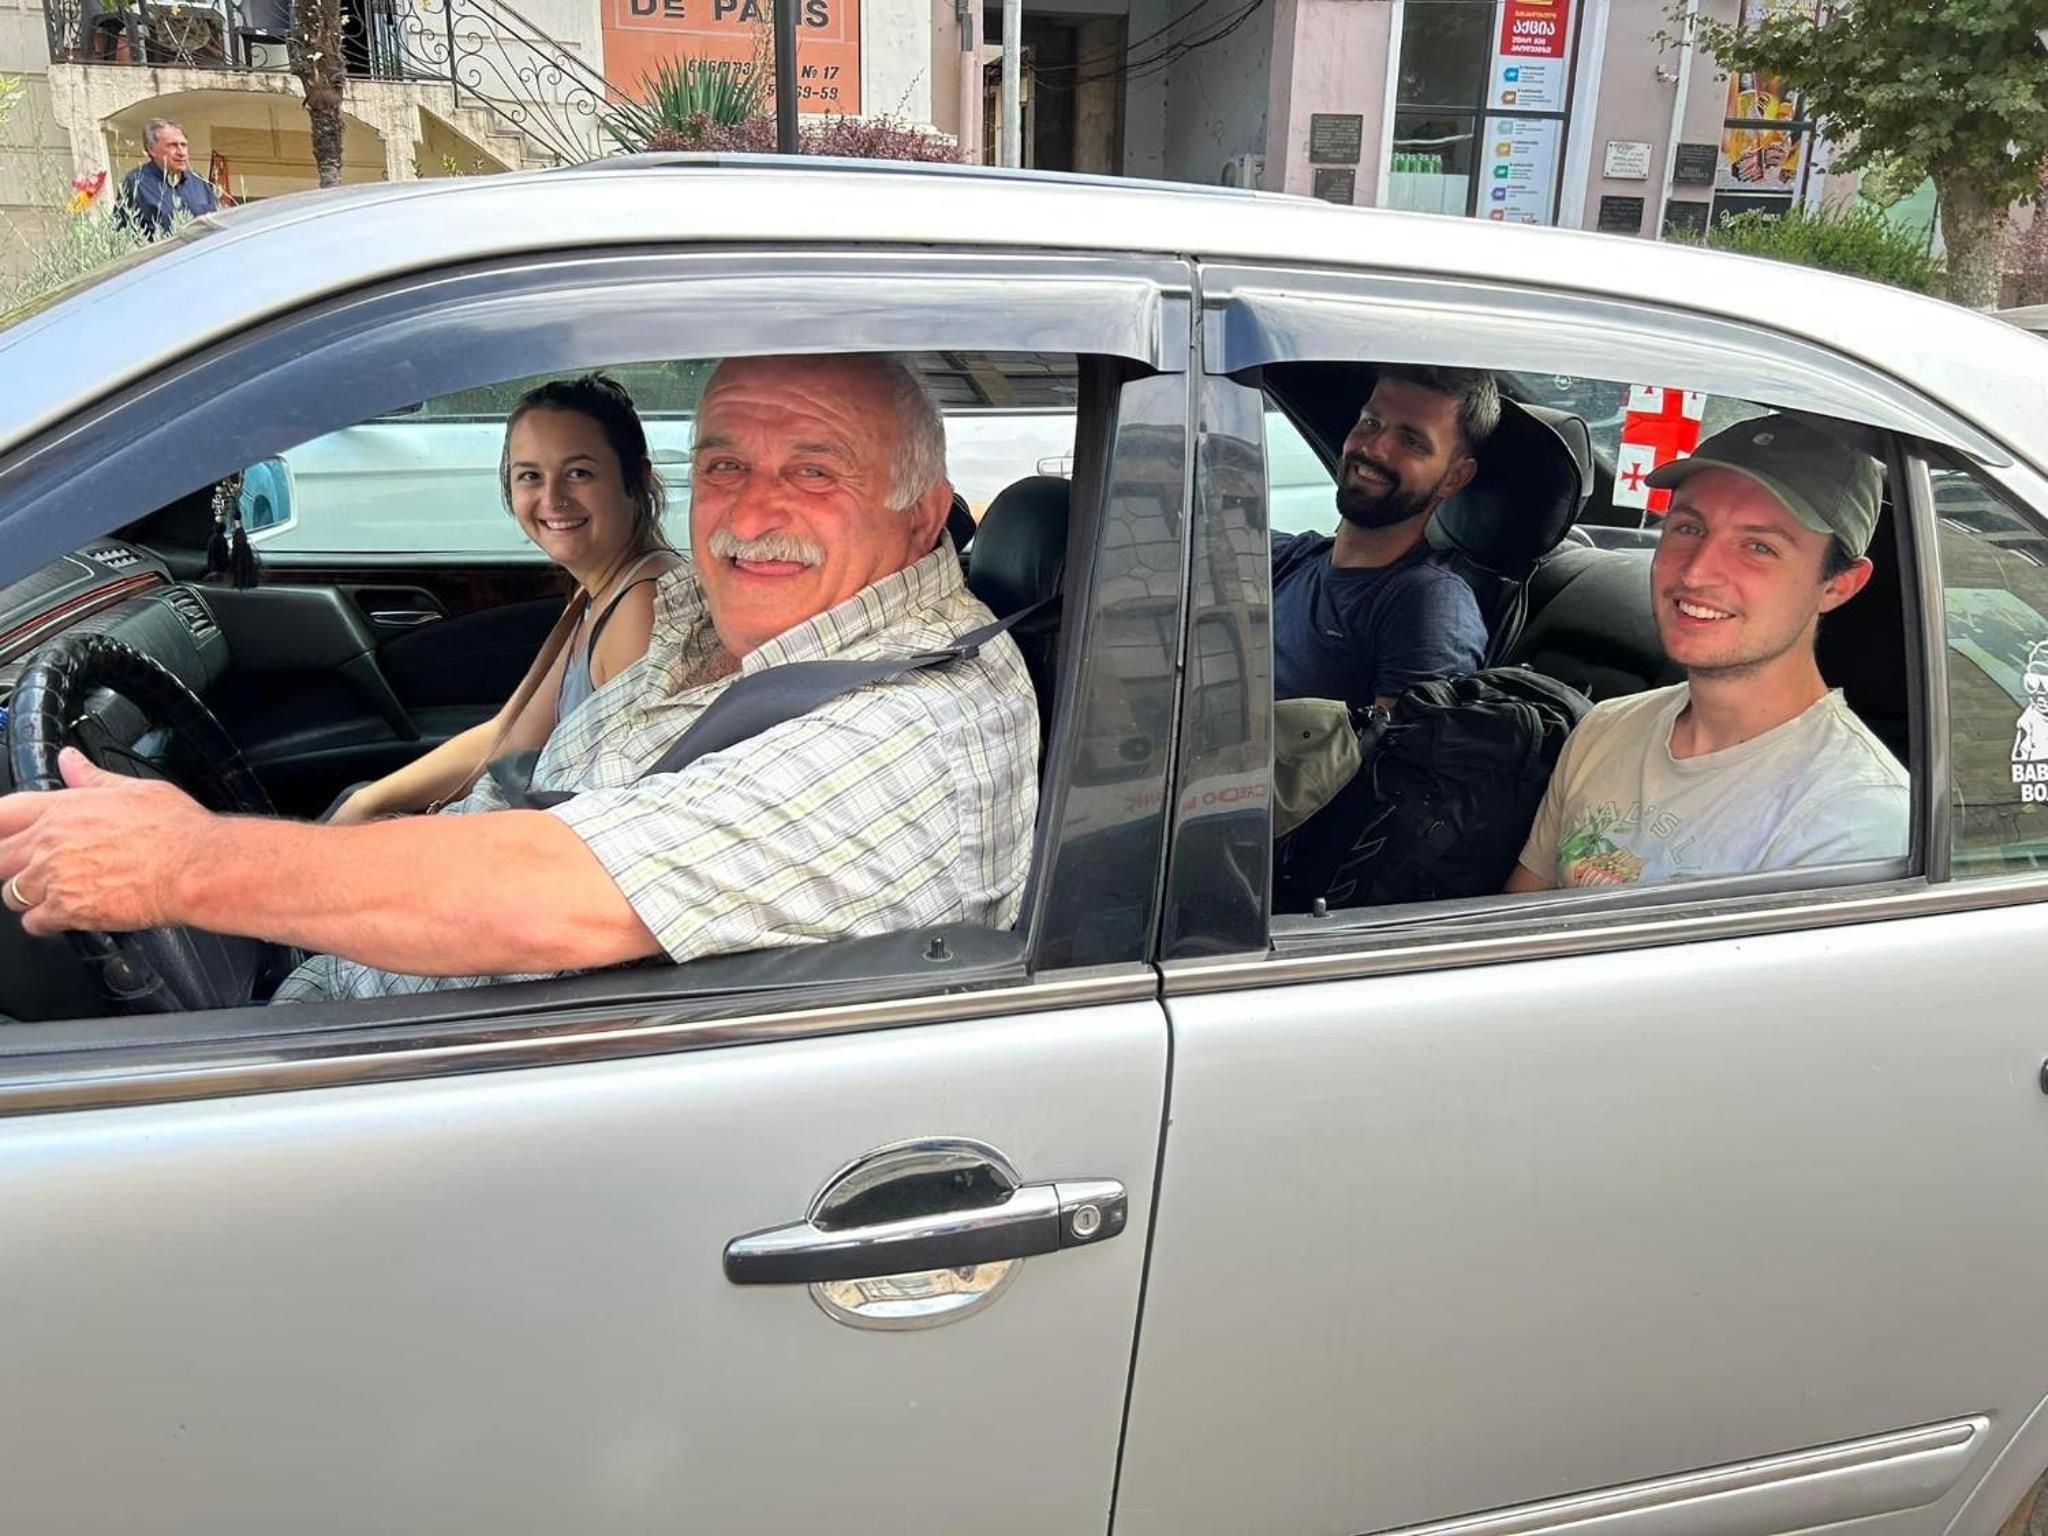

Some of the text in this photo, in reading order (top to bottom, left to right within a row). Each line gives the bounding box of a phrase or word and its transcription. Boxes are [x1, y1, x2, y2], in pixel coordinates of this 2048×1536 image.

[631, 0, 830, 27] DE PAIS
[1513, 19, 1556, 36] აქცია
[824, 66, 839, 80] 17
[2011, 763, 2048, 783] BAB
[2021, 783, 2048, 802] BO
